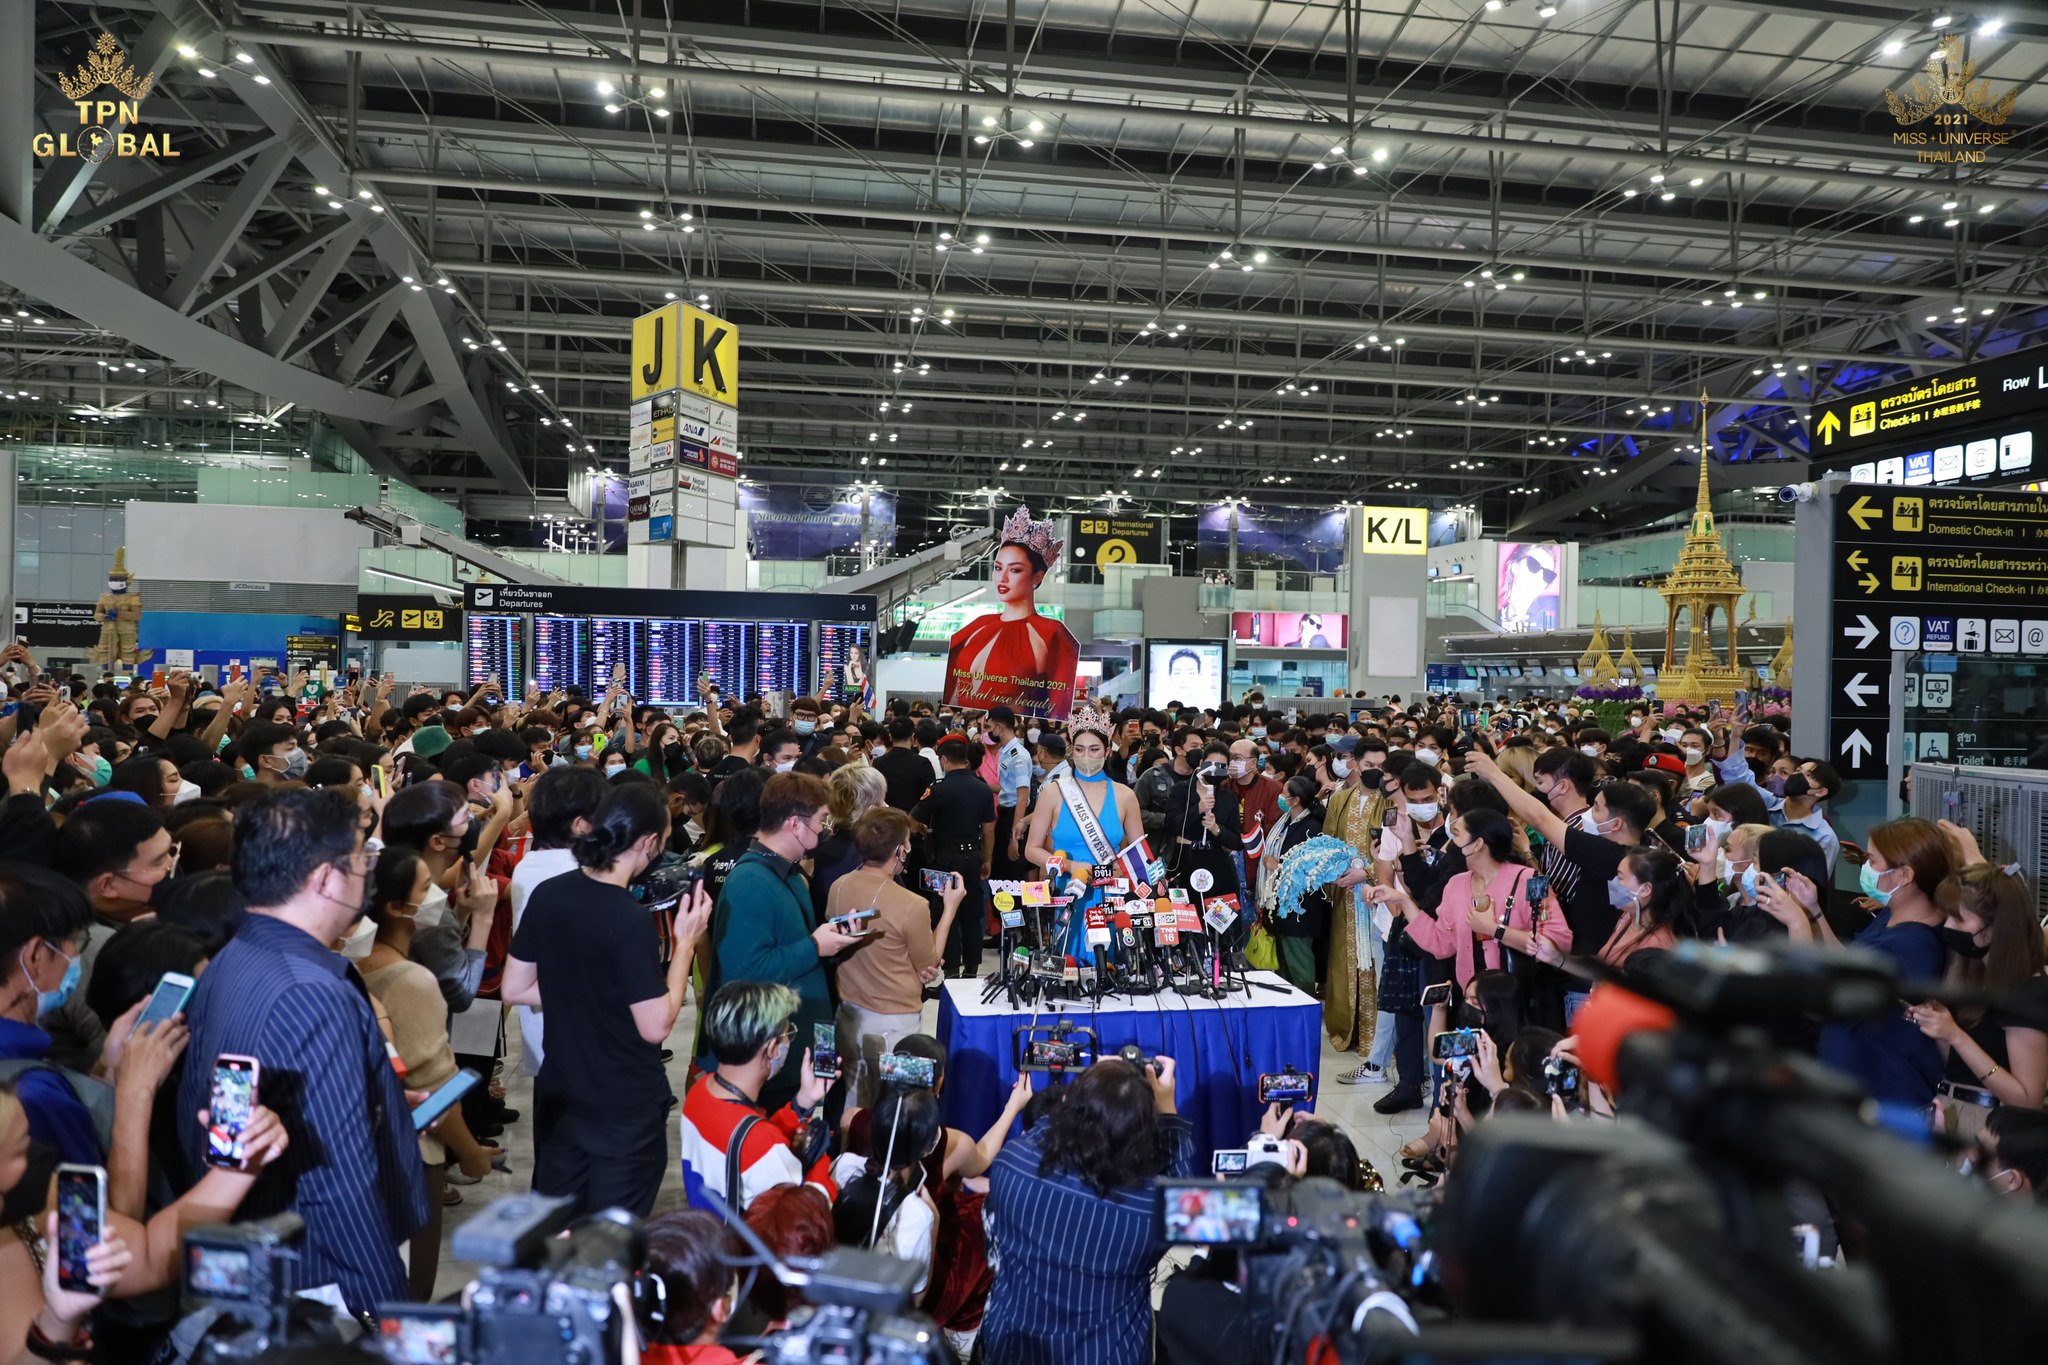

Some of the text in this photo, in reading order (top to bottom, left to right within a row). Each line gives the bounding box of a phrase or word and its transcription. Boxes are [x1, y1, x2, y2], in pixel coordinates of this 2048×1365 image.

[642, 316, 664, 386] J
[694, 317, 728, 394] K
[2003, 365, 2048, 391] Row L
[1880, 376, 1977, 409] ตรวจบัตรโดยสาร
[1880, 413, 1921, 430] Check-in
[683, 423, 698, 435] ANA
[1908, 454, 1930, 469] VAT
[692, 476, 705, 486] Nepal
[691, 485, 707, 494] Airlines
[1112, 520, 1154, 529] International
[1367, 516, 1423, 545] K/L
[1928, 523, 2014, 537] Domestic Check-in
[1112, 528, 1149, 537] Departures
[1108, 545, 1126, 563] 2
[1926, 581, 2026, 595] International Check-in
[500, 599, 543, 609] Departures
[57, 618, 81, 626] Baggage
[1927, 620, 1950, 633] VAT
[1926, 633, 1951, 641] REFUND
[953, 668, 1067, 691] Miss Universe Thailand 2021
[956, 680, 1057, 715] Real size beauty
[1956, 732, 1977, 747] สุขา
[1956, 755, 1985, 766] Toilet
[1073, 802, 1090, 822] MISS
[1164, 933, 1175, 942] 16
